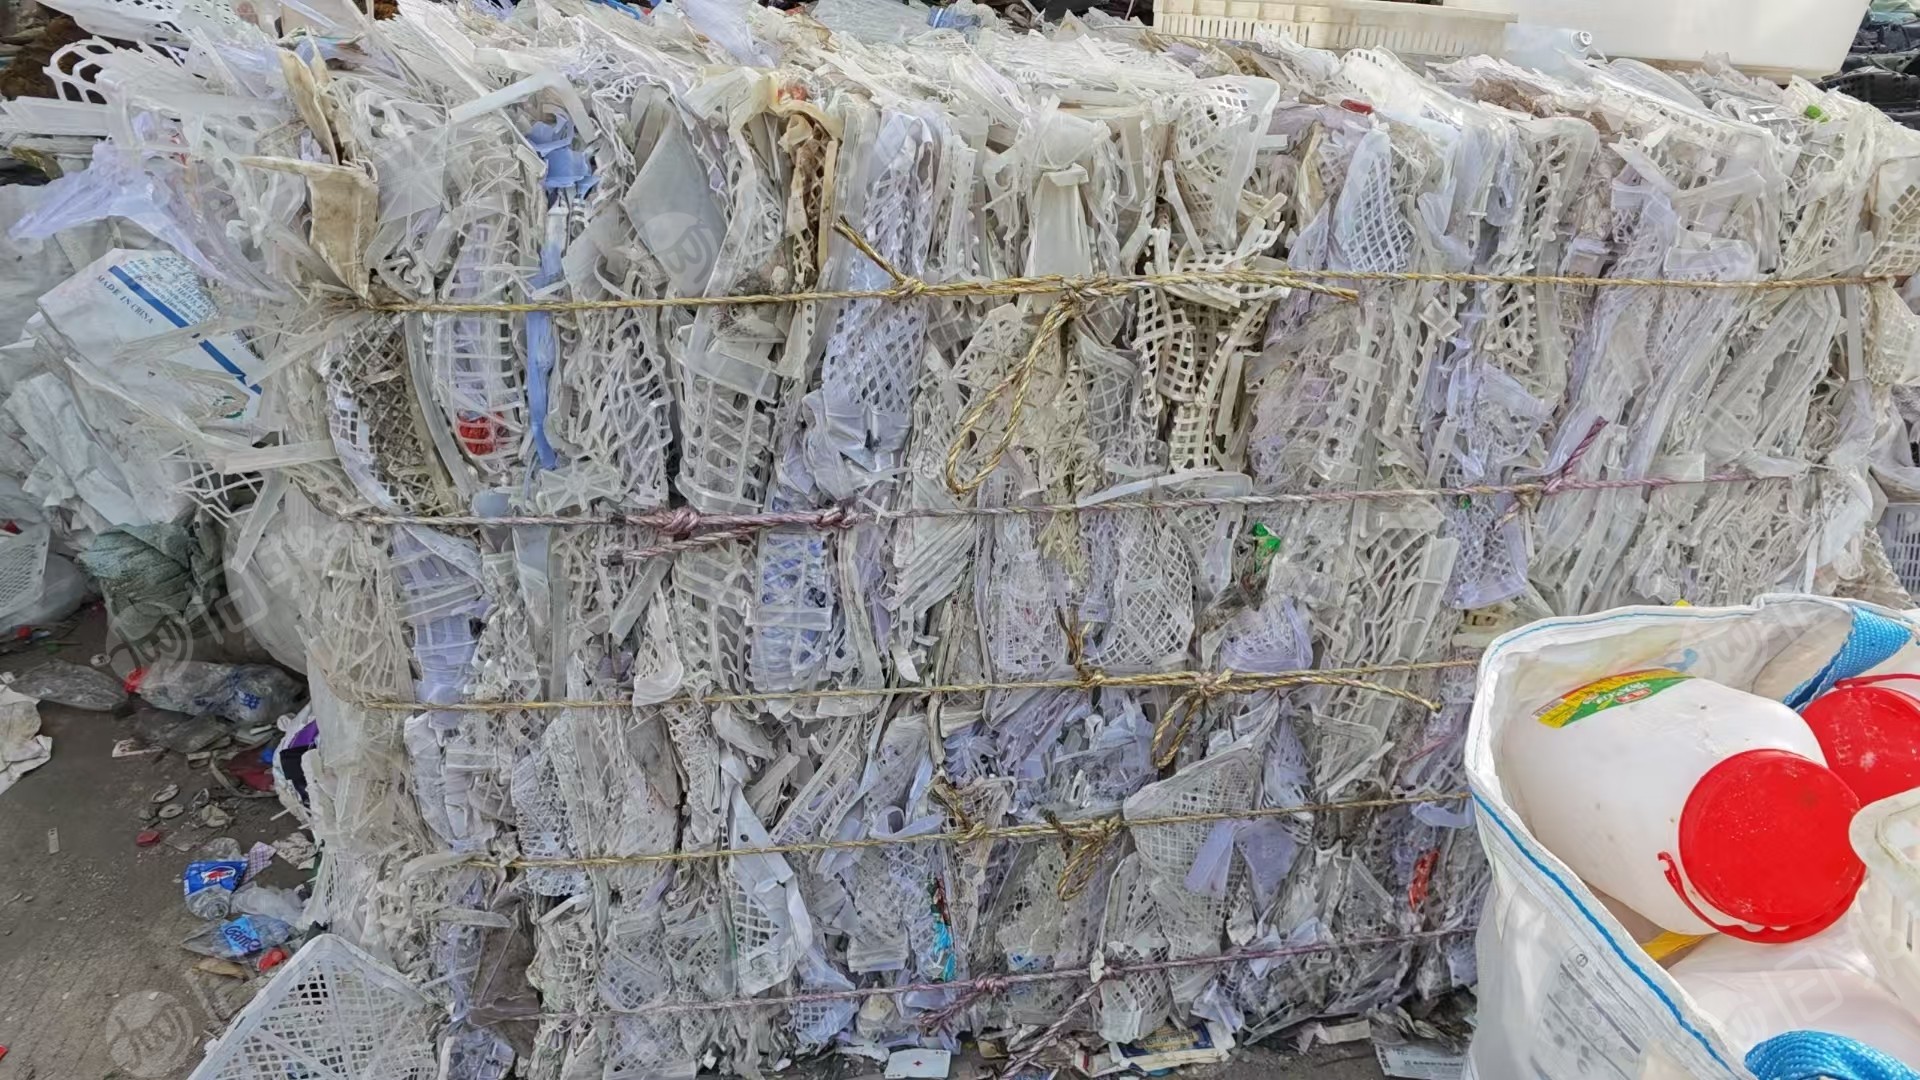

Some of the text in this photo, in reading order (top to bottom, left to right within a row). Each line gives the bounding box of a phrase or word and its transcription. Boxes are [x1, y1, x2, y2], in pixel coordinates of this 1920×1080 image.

[97, 274, 121, 296] MADE
[120, 295, 131, 305] IN
[131, 304, 154, 324] CHINA
